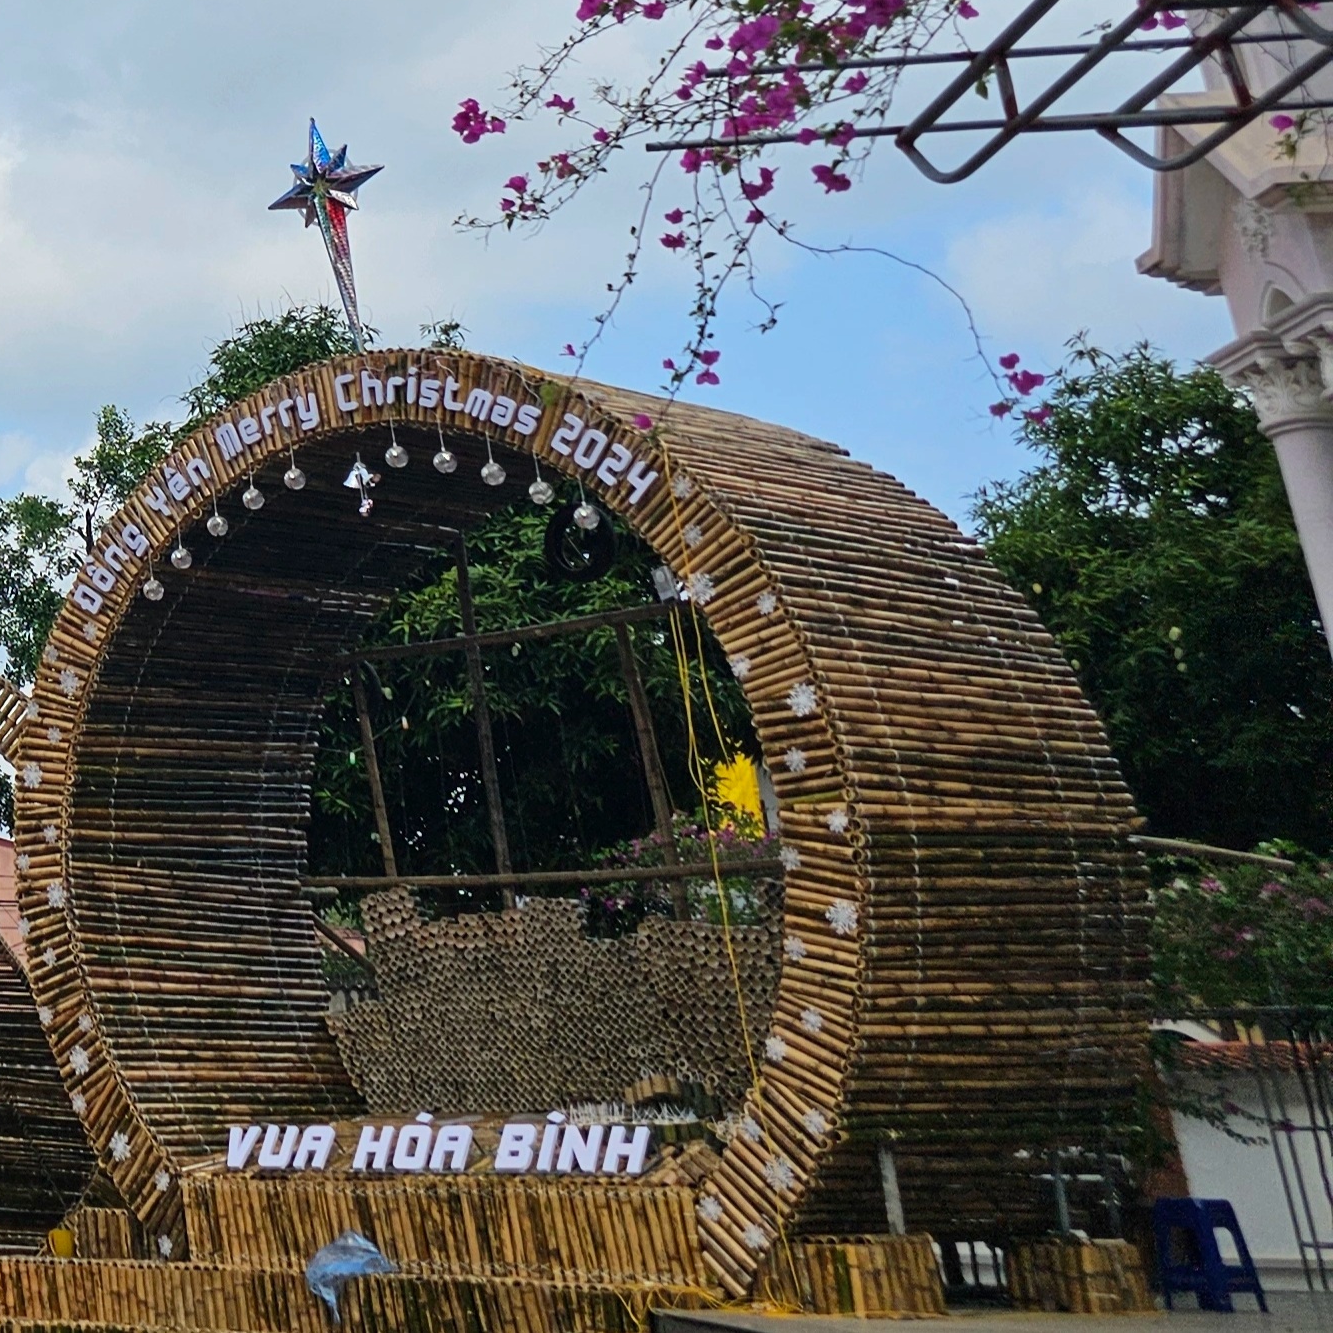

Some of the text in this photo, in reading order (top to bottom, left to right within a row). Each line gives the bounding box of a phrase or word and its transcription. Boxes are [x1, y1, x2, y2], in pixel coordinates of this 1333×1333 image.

[145, 457, 211, 516] Yên
[215, 392, 320, 461] Merry
[334, 367, 542, 436] Christmas
[550, 413, 659, 505] 2024
[227, 1110, 651, 1175] VUA HÒA BÌNH
